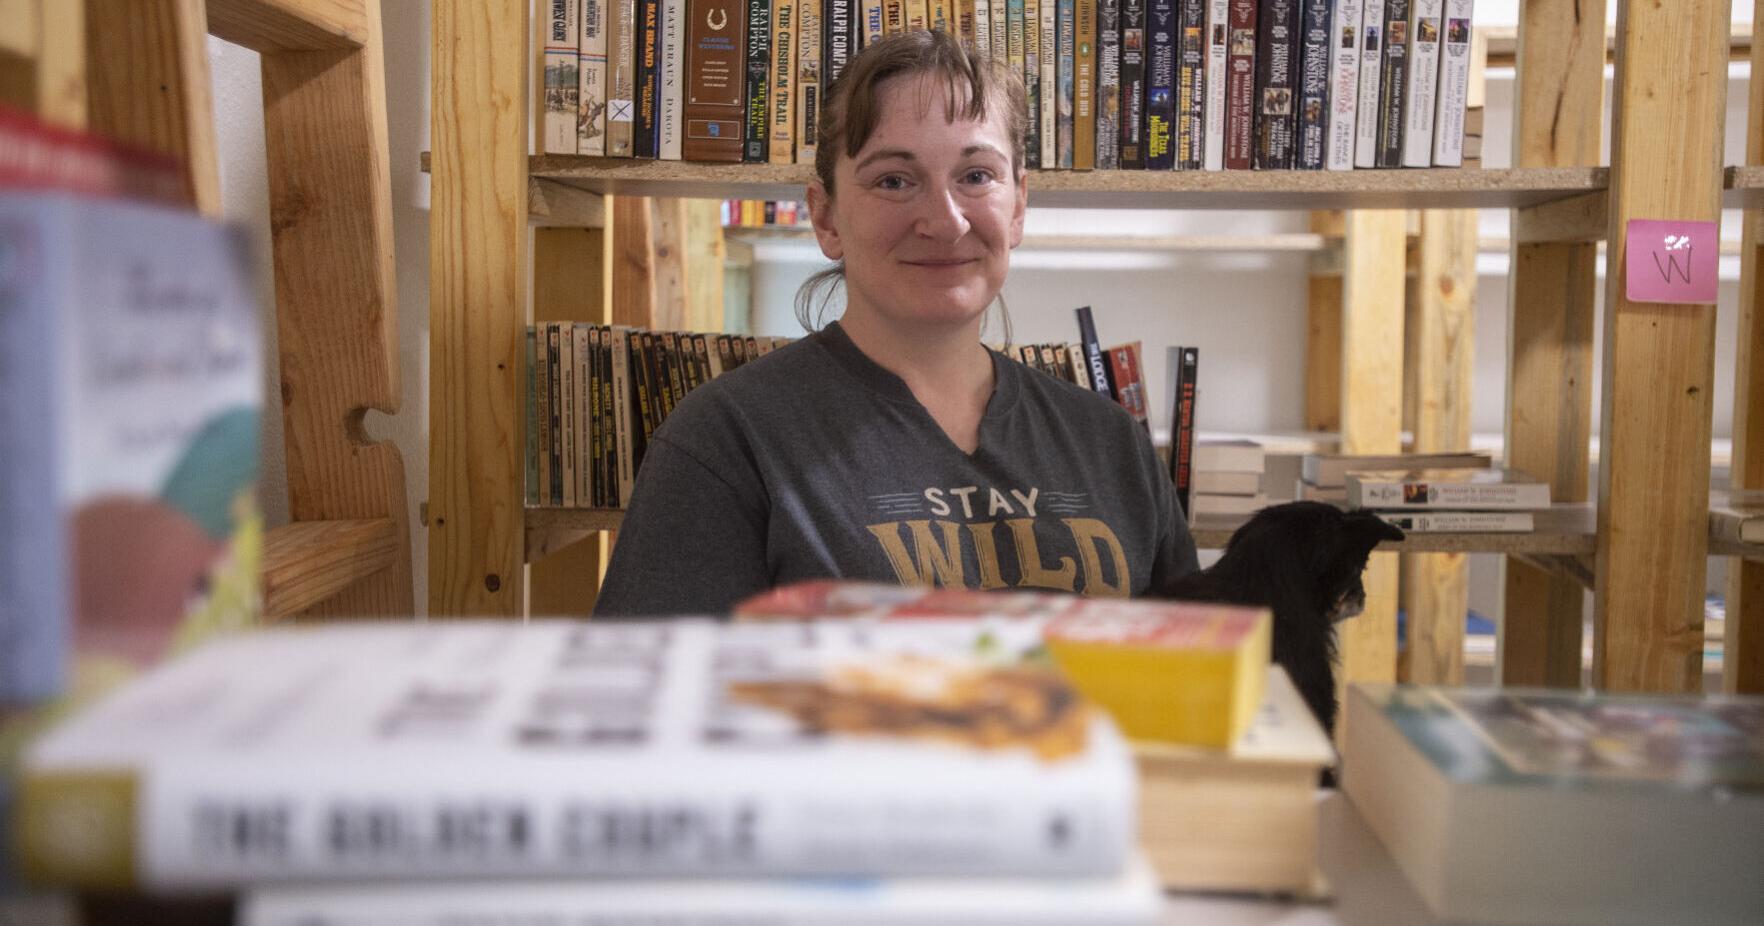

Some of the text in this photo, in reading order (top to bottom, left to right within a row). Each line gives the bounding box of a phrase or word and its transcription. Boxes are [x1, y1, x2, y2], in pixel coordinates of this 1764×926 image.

[646, 3, 656, 27] MAX
[749, 0, 759, 57] COMPTON
[758, 8, 768, 50] RALPH
[779, 5, 791, 28] THE
[802, 3, 811, 58] COMPTON
[833, 0, 847, 33] RALPH
[869, 7, 881, 32] THE
[887, 2, 900, 26] THE
[1081, 1, 1089, 35] JOHNSON
[645, 29, 655, 68] BRAND
[666, 6, 675, 87] MATT BRAUN
[1061, 18, 1073, 57] LONGARM
[777, 31, 790, 88] CHISHOLM
[1111, 45, 1119, 77] WILLIAM
[1153, 45, 1163, 87] JOHNSTONE
[1163, 45, 1171, 76] WILLIAM
[1271, 43, 1281, 83] JOHNSTONE
[1304, 42, 1320, 93] JOHNSTONE
[1318, 45, 1327, 79] WILLIAM
[1080, 63, 1089, 116] THE COLD DISH
[1394, 67, 1402, 96] WILLIAM
[1456, 65, 1465, 96] WILLIAM
[665, 98, 674, 145] DAKOTA
[751, 97, 759, 126] TRAIL
[757, 81, 766, 139] THE EMPIRE
[776, 91, 789, 125] TRAIL
[1240, 74, 1251, 159] WILLIAM W. JOHNSTONE
[1159, 121, 1170, 154] THE TEXAS
[1193, 117, 1201, 162] JOHNSTONE
[1391, 107, 1400, 150] JOHNSTONE
[1453, 107, 1462, 151] JOHNSTONE
[1652, 245, 1693, 285] W
[1090, 356, 1109, 392] LODGE
[924, 486, 1040, 518] STAY
[866, 517, 1131, 598] WILD
[192, 797, 293, 862] THE
